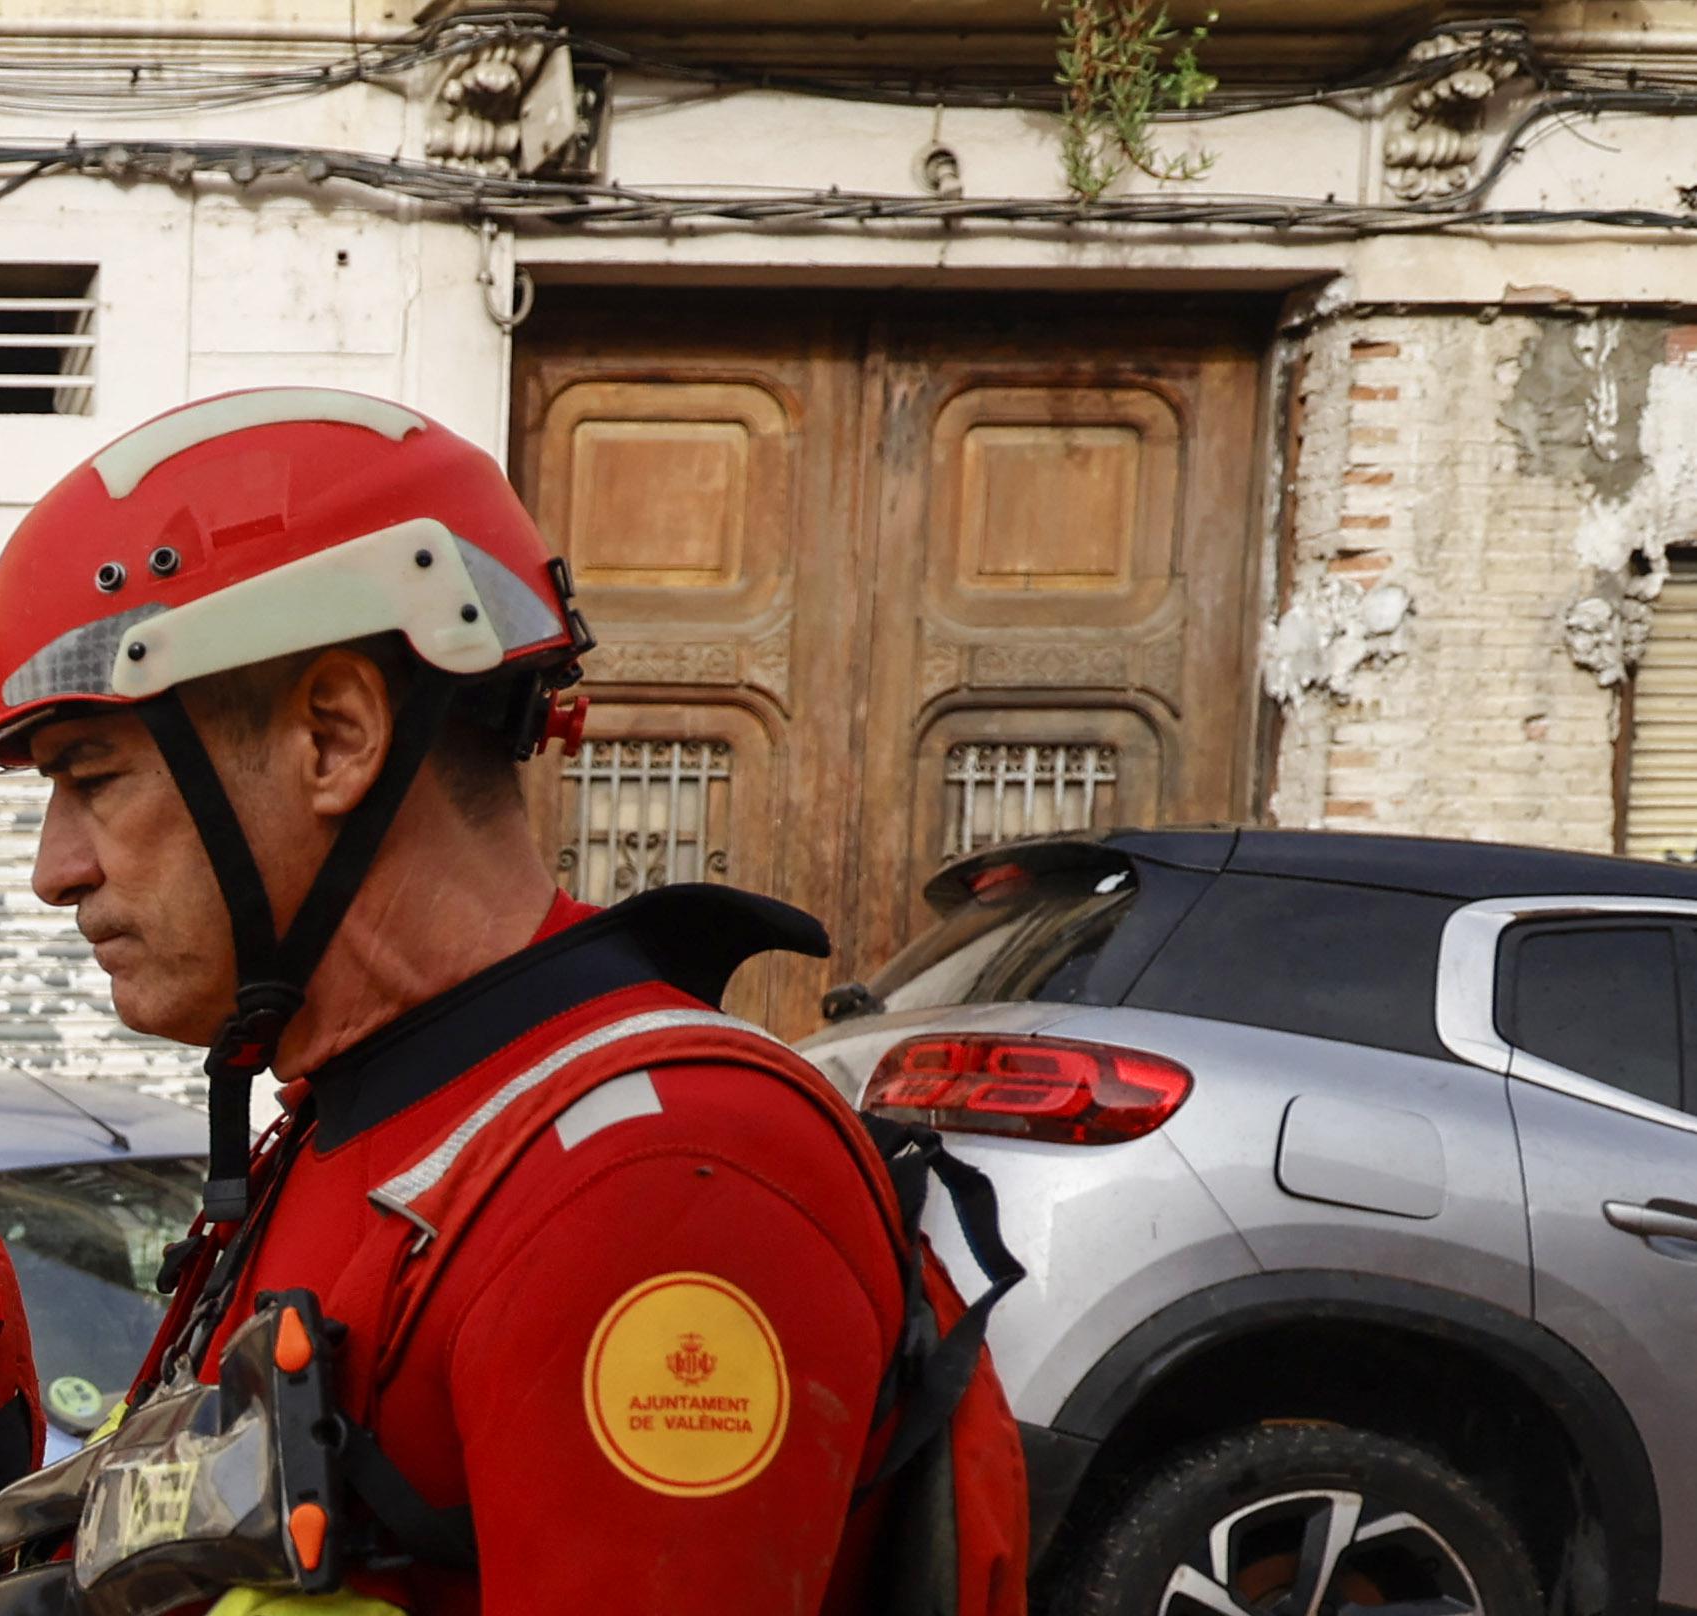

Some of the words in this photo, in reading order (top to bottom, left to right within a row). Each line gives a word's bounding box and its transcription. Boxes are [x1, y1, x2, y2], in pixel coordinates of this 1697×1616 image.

[629, 1395, 750, 1412] AJUNTAMENT
[629, 1415, 654, 1430] DE
[664, 1409, 753, 1433] VALÈNCIA
